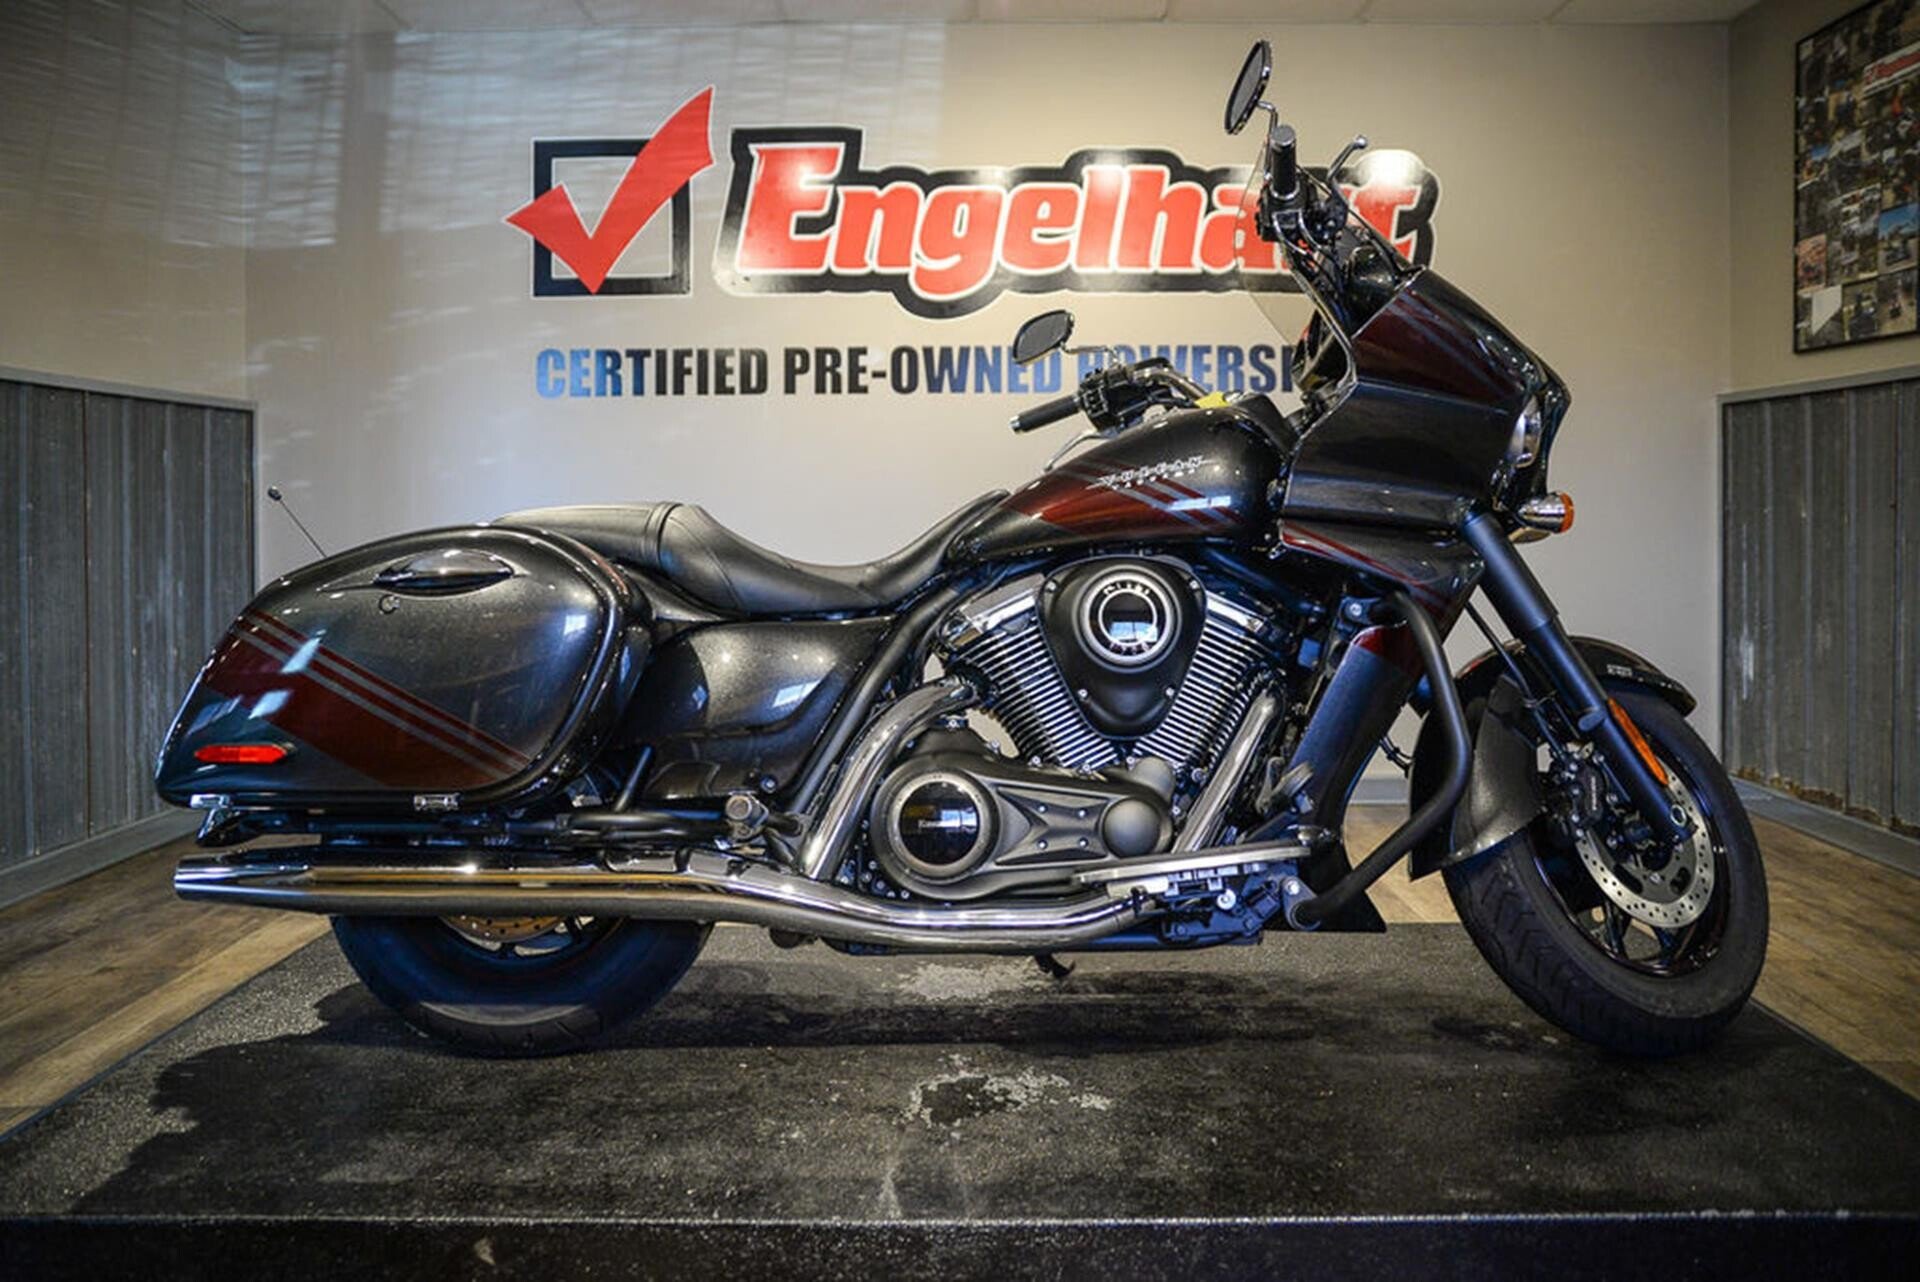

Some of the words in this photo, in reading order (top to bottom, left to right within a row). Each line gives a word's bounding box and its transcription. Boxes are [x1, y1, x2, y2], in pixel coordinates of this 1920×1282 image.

[735, 142, 1421, 299] Engelhat
[535, 348, 769, 398] CERTIFIED
[783, 345, 1062, 394] PRE-OWNED
